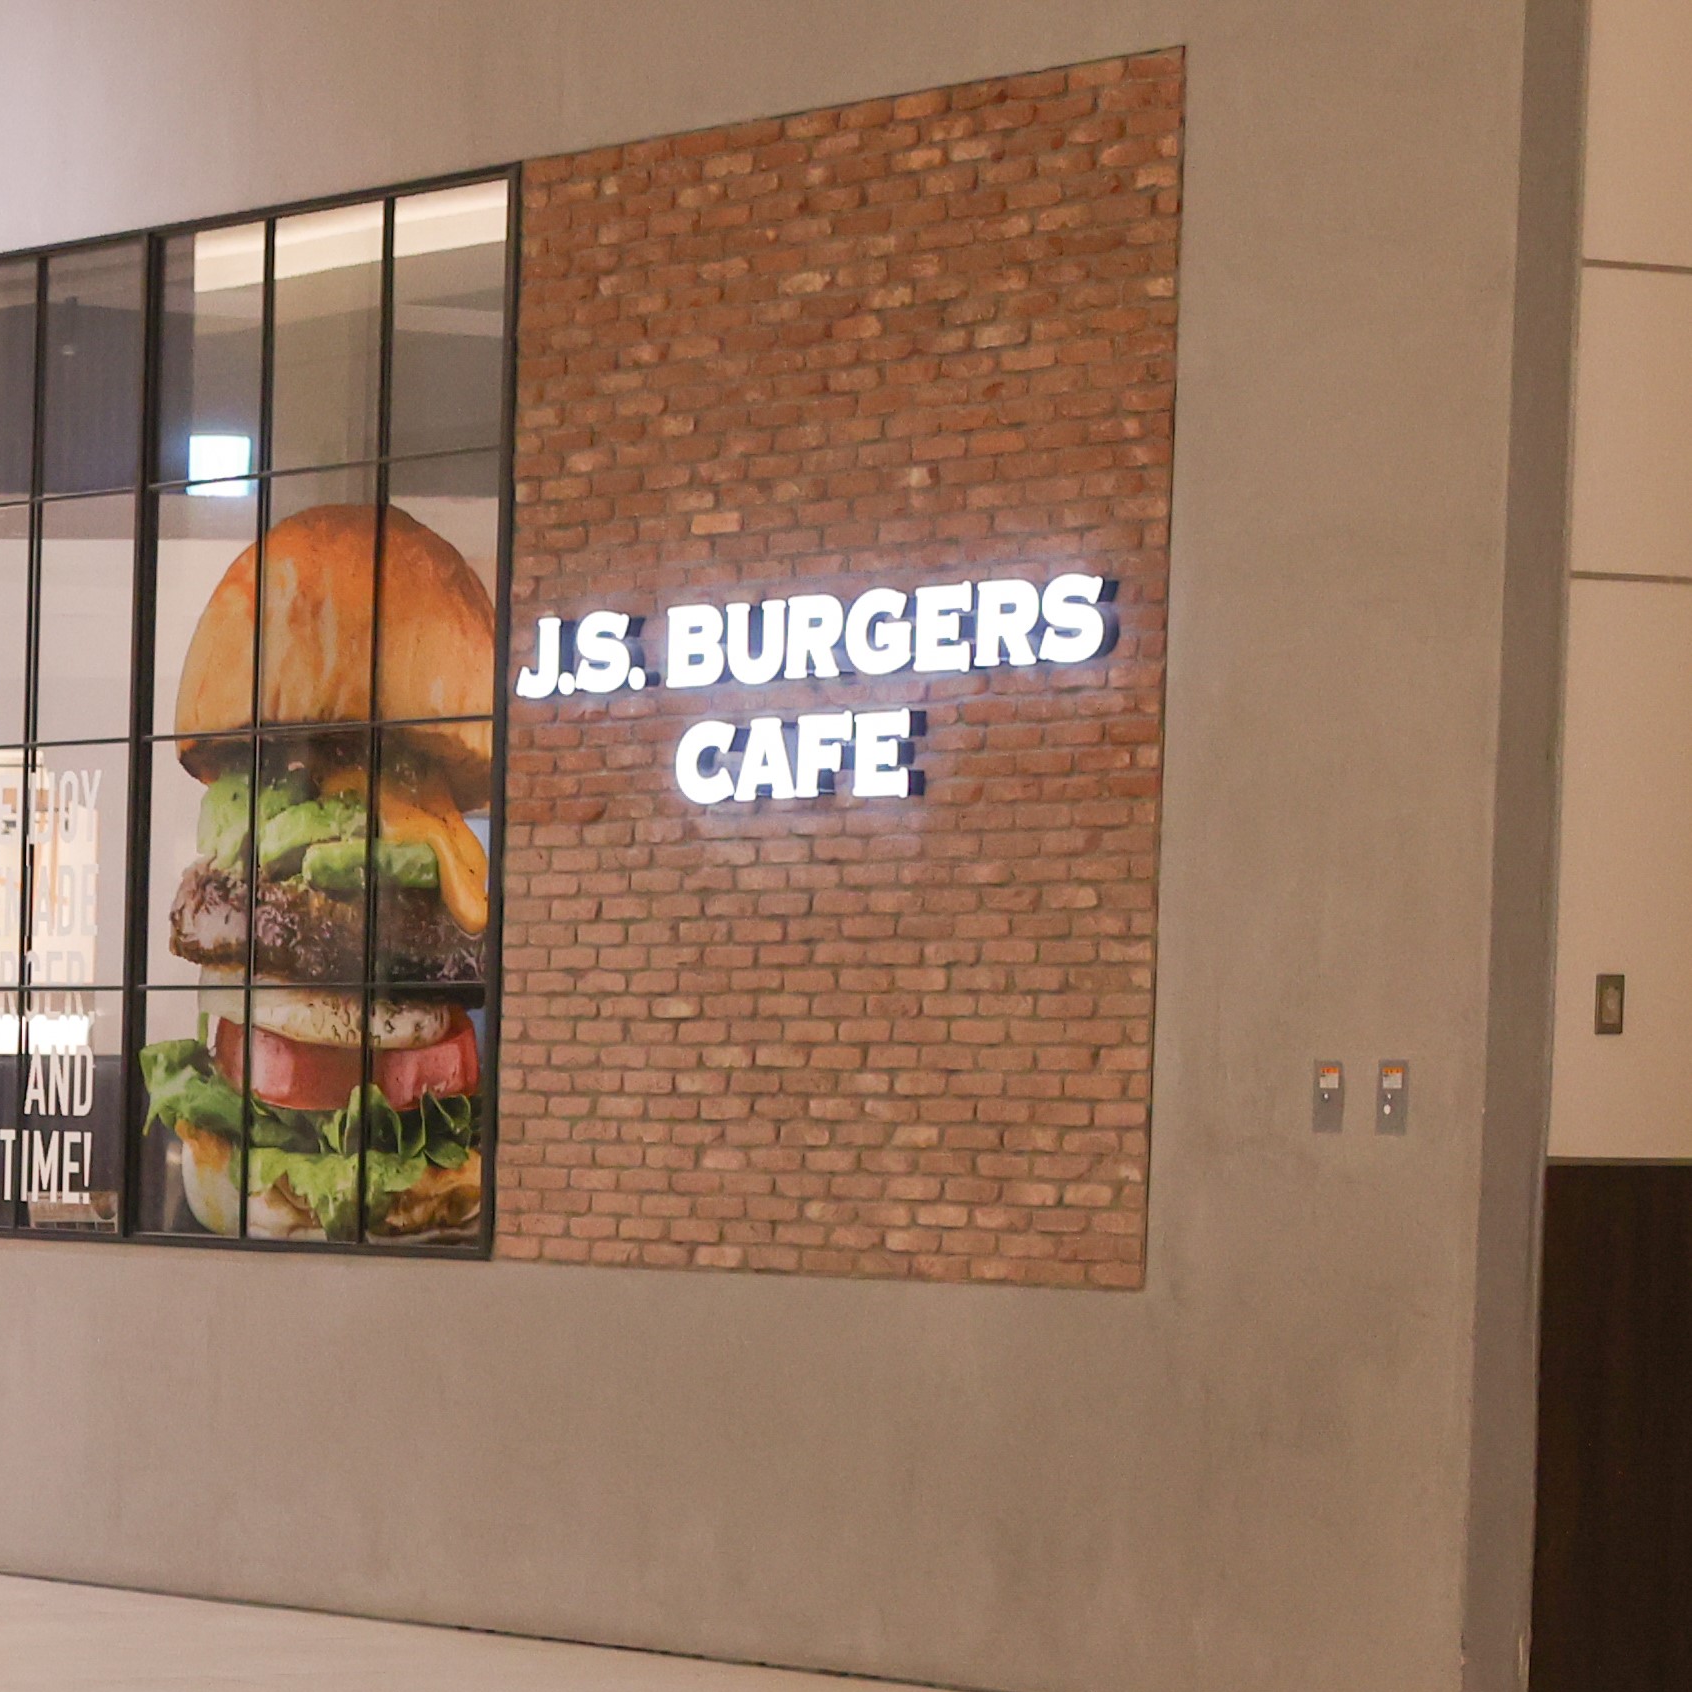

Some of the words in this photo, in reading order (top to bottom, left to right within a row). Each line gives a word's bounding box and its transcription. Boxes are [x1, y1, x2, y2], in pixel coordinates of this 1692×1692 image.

[516, 609, 648, 699] J.S.
[664, 573, 1106, 690] BURGERS
[674, 707, 912, 804] CAFE
[23, 1044, 94, 1118] AND
[0, 1128, 93, 1205] TIME!
